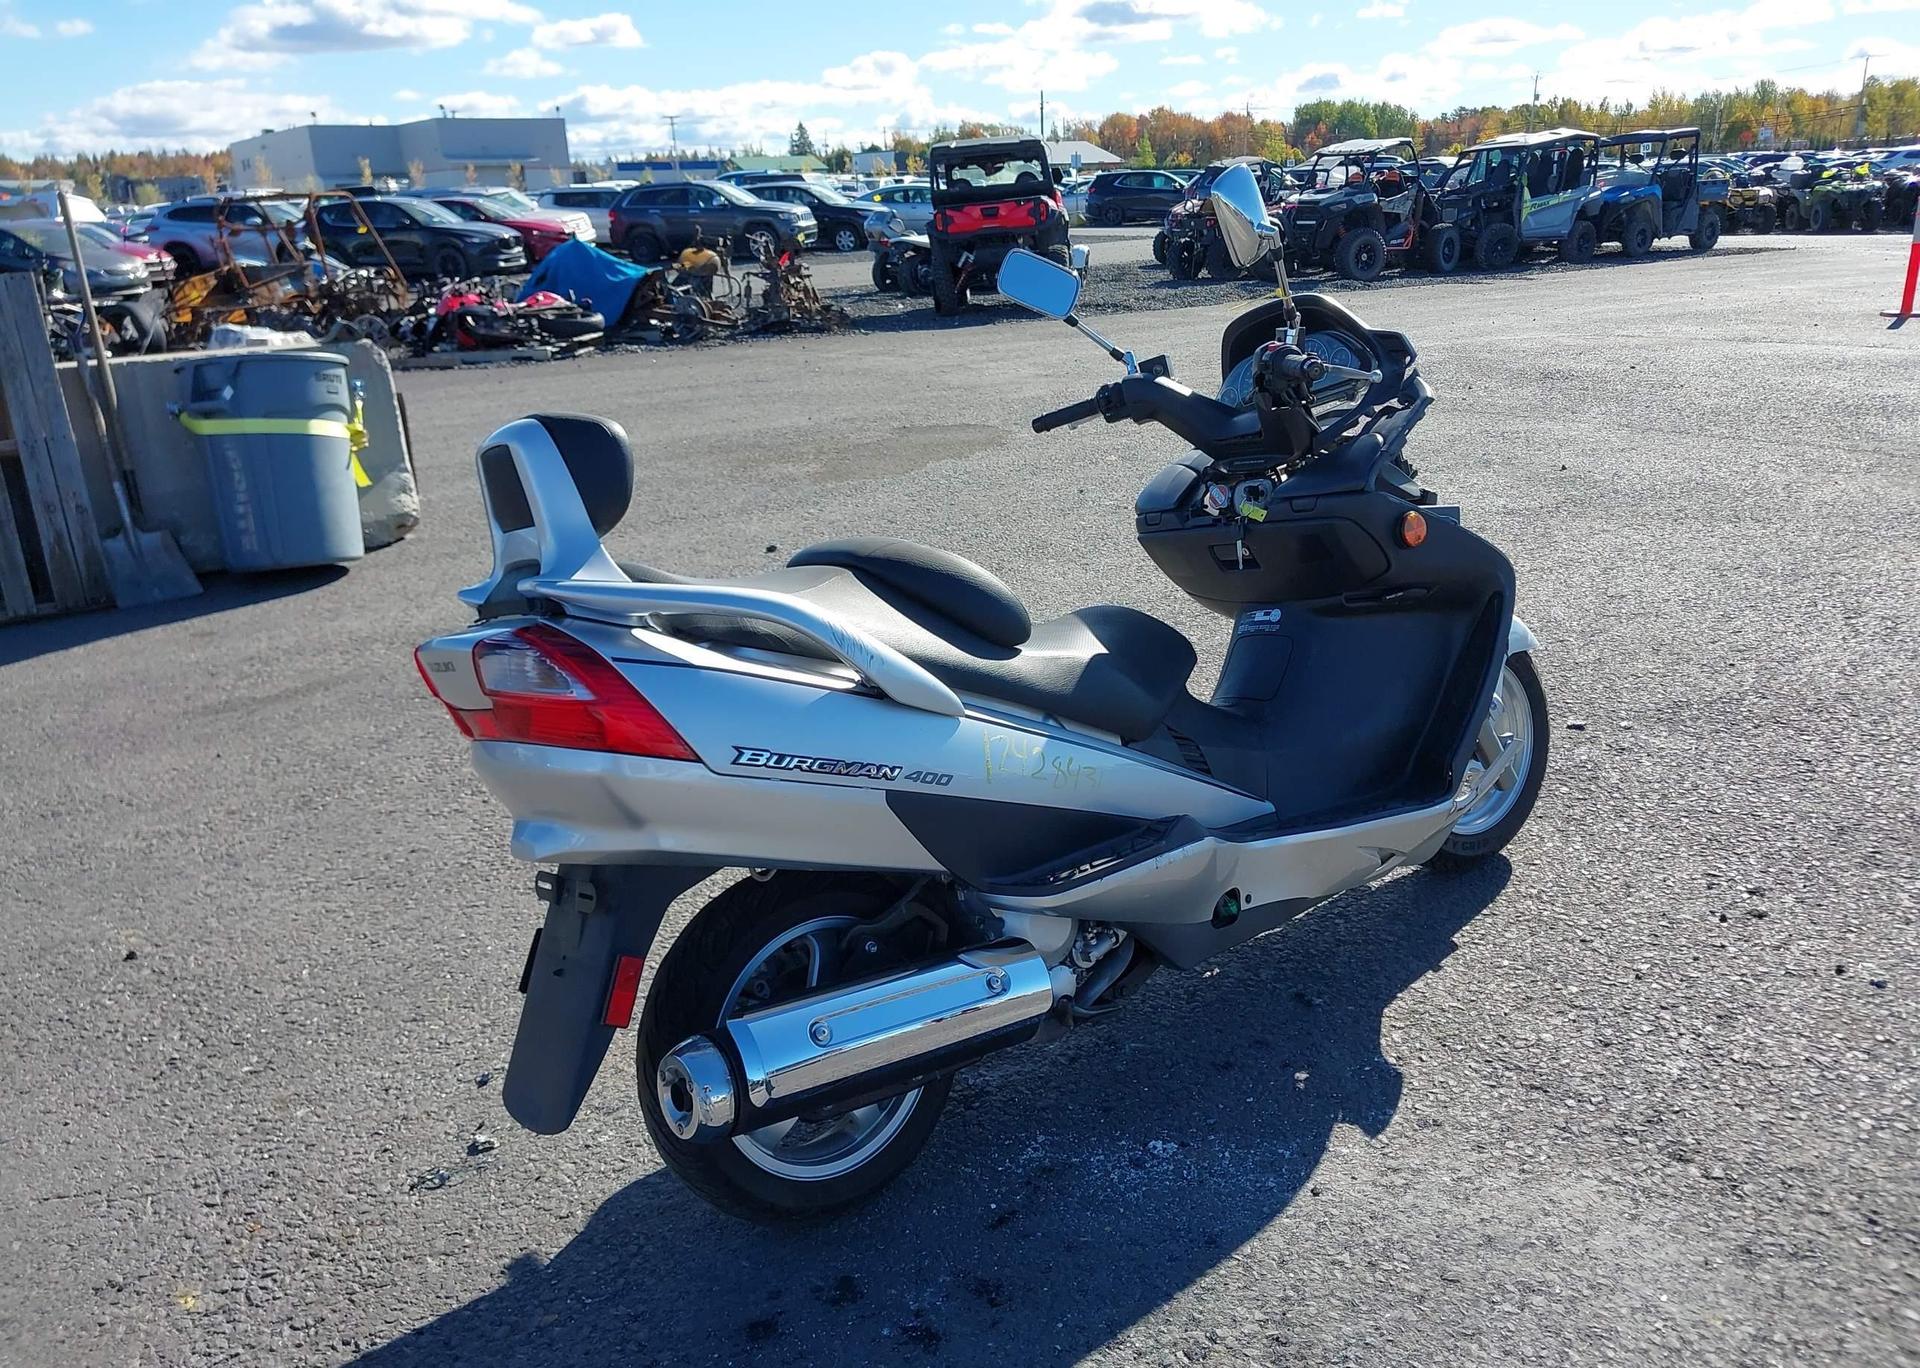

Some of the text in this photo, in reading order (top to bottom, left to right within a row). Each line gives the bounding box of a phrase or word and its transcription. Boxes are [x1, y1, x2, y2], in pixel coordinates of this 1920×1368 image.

[1641, 143, 1651, 152] 10
[731, 745, 954, 787] BURGMAN 400
